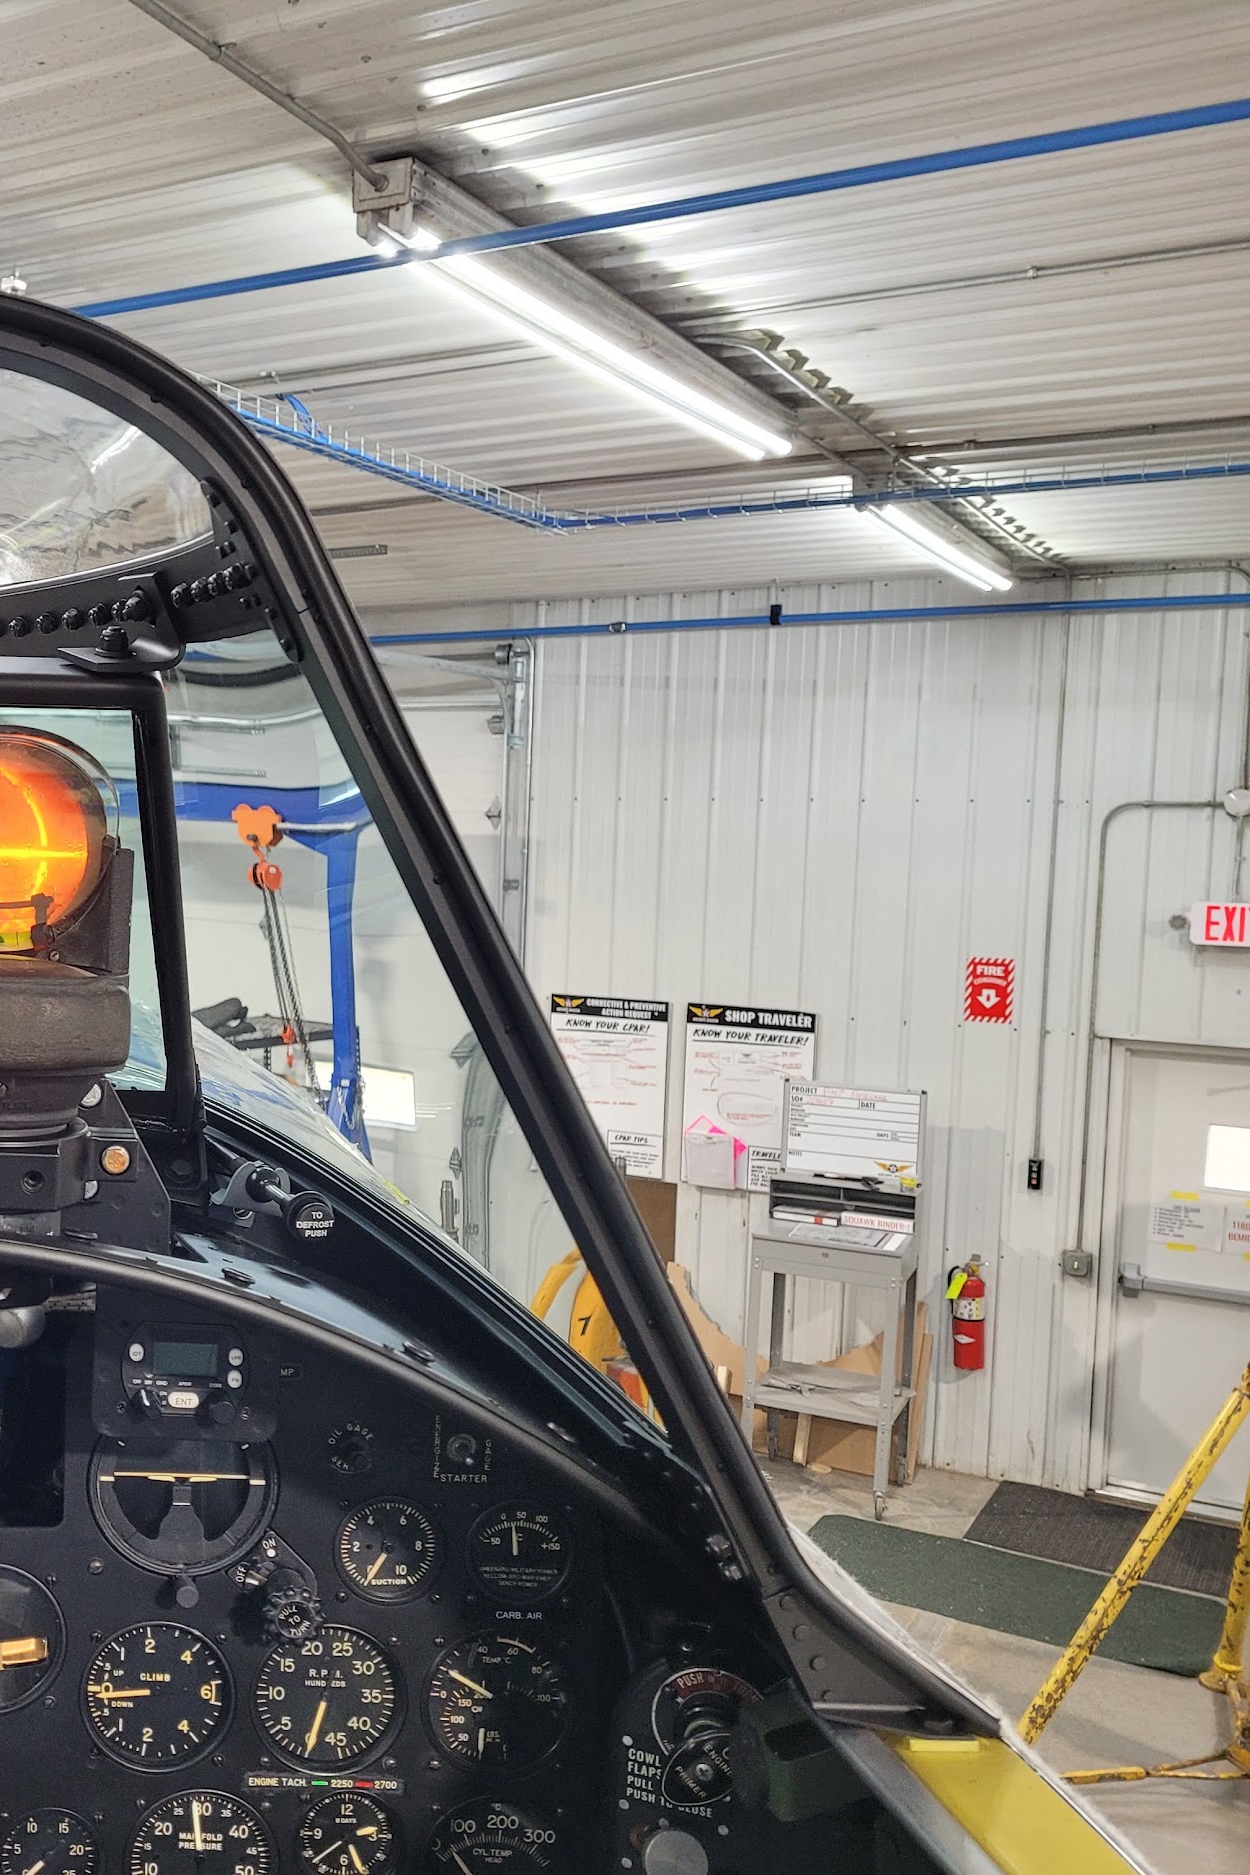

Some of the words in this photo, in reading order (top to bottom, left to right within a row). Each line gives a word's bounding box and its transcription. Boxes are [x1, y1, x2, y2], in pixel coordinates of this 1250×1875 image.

[1204, 904, 1250, 943] EXI
[976, 964, 1006, 977] FIRE
[586, 998, 623, 1009] CORRECTIVE
[624, 1001, 629, 1009] &
[630, 1002, 667, 1013] PREVENTIVE
[601, 1008, 624, 1018] ACTION
[624, 1010, 652, 1020] REQUEST
[724, 1009, 756, 1024] SHOP
[757, 1012, 813, 1029] TRAVELER
[565, 1019, 592, 1027] KNOW
[596, 1020, 619, 1030] YOUR
[622, 1022, 650, 1034] CPAR!
[693, 1028, 722, 1038] KNOW
[726, 1031, 751, 1041] YOUR
[754, 1033, 809, 1046] TRAVELER!
[791, 1085, 817, 1095] PROJECT
[860, 1102, 876, 1110] DATE
[311, 1211, 323, 1220] TO
[844, 1215, 875, 1227] SQUAWK
[295, 1220, 335, 1229] DEFROST
[305, 1229, 327, 1238] PUSH
[281, 1368, 294, 1377] MP
[440, 1475, 488, 1483] STARTER
[370, 1578, 407, 1586] SUCTION
[495, 1610, 524, 1620] CARB.
[526, 1611, 543, 1620] AIR
[140, 1673, 171, 1682] CLIMB
[628, 1748, 662, 1767] COWL
[627, 1761, 662, 1780] FLAPS
[248, 1777, 279, 1787] ENGINE
[282, 1778, 307, 1787] TACH.
[330, 1779, 354, 1788] 2250
[374, 1780, 398, 1790] 2700
[675, 1765, 707, 1799] PRIMER
[487, 1815, 519, 1829] 200
